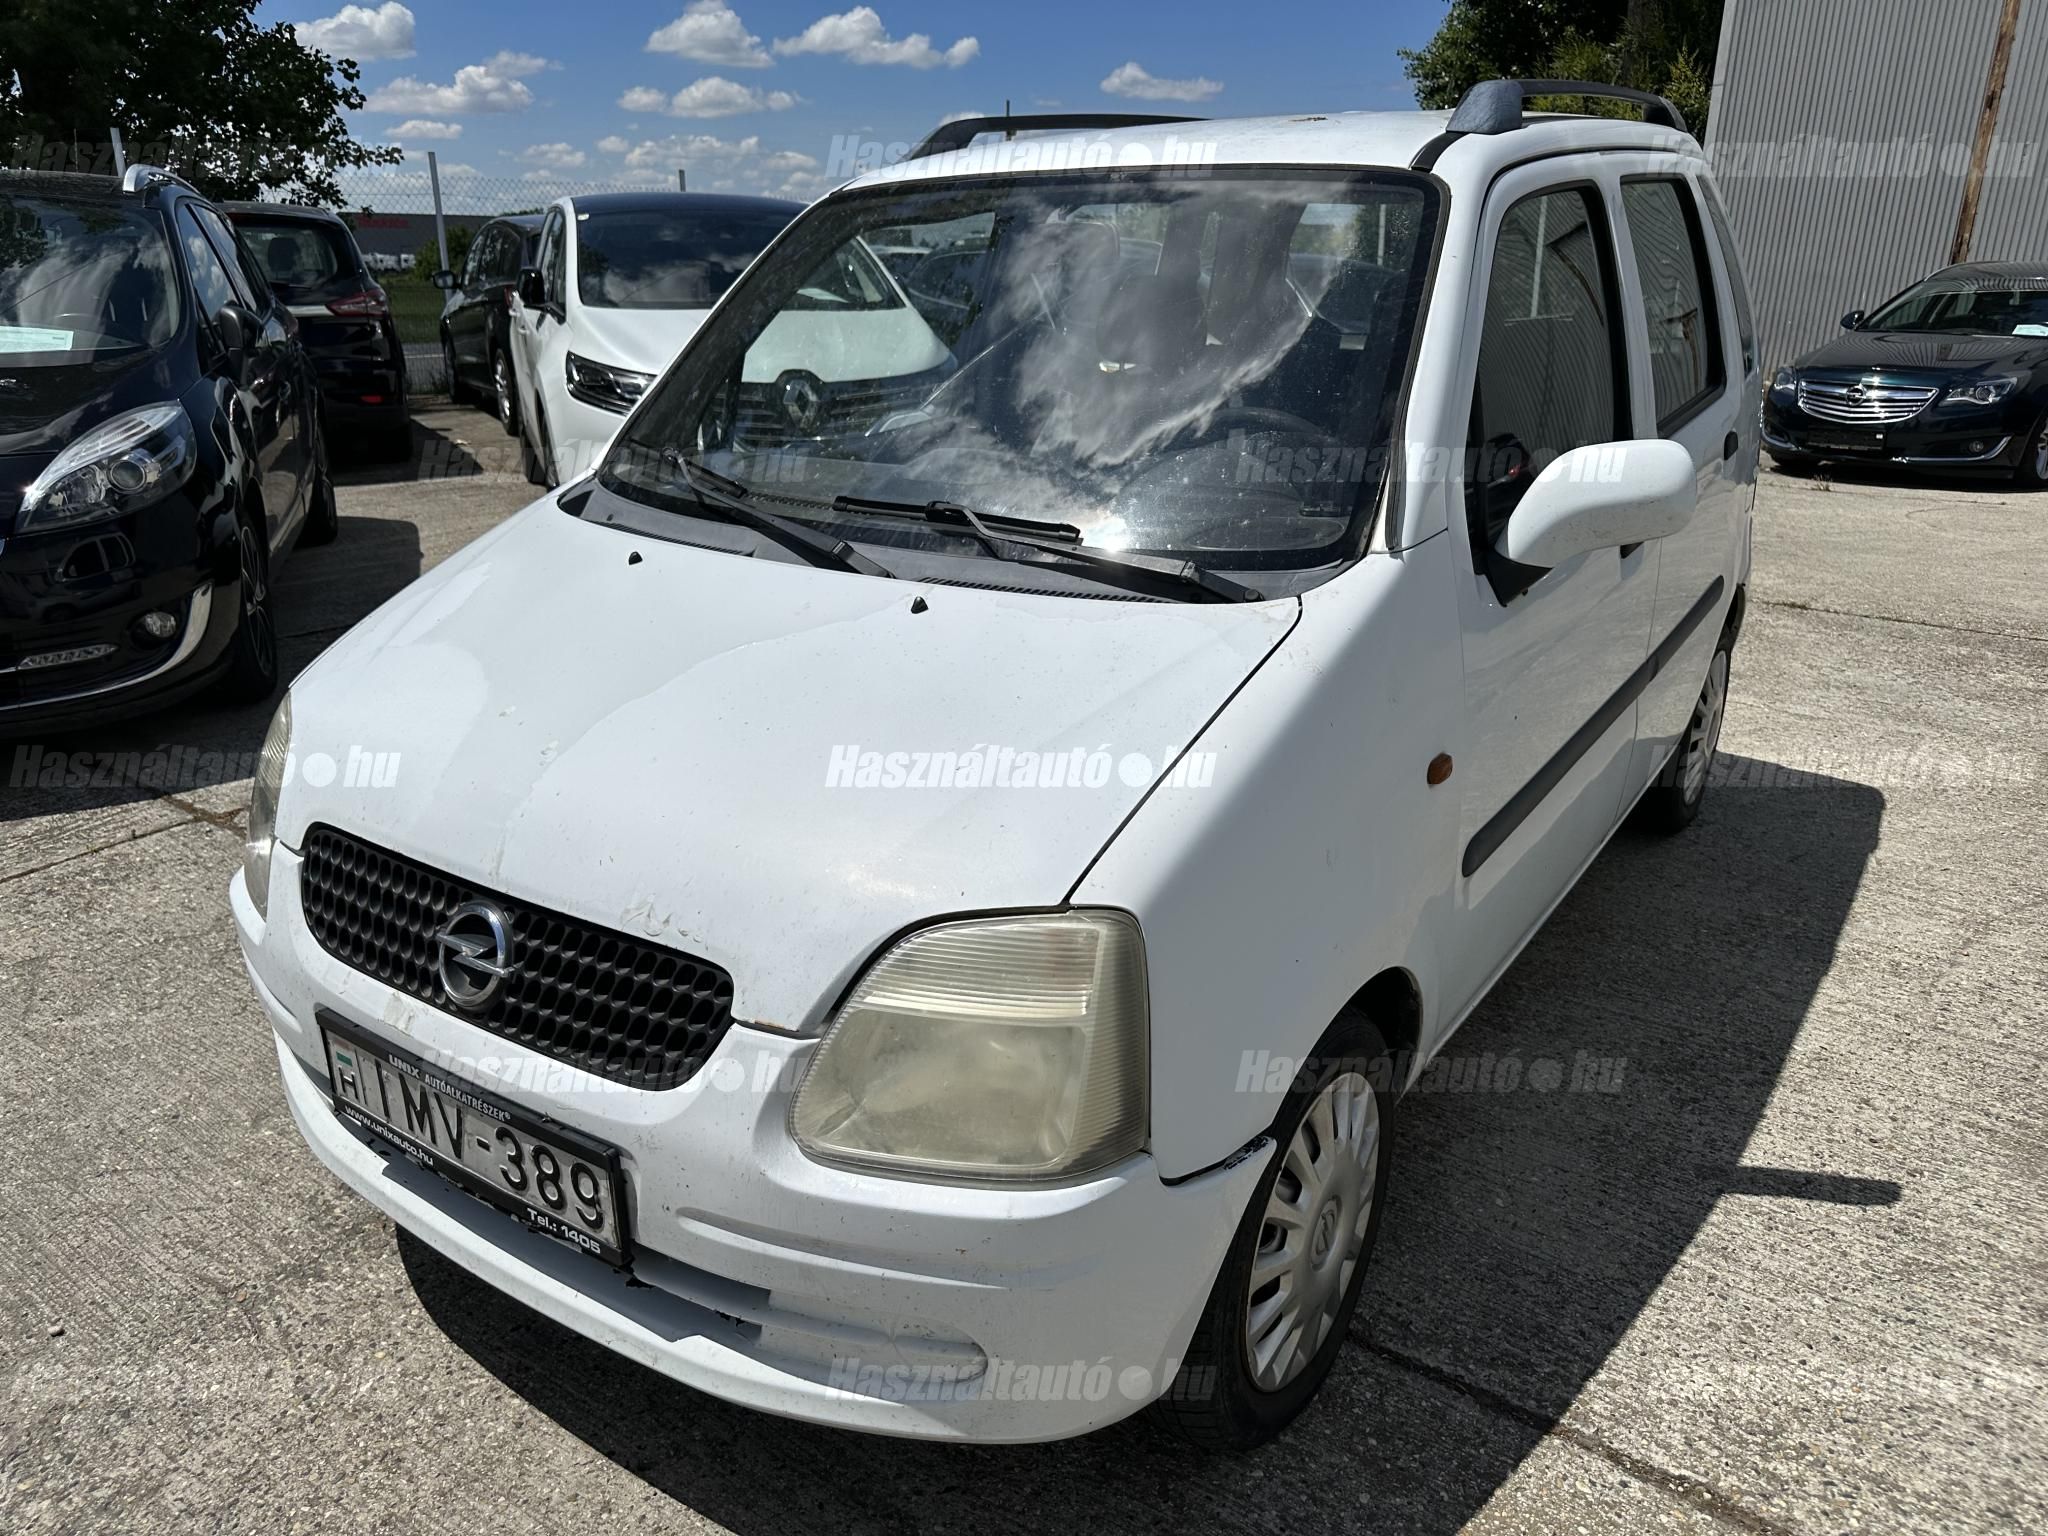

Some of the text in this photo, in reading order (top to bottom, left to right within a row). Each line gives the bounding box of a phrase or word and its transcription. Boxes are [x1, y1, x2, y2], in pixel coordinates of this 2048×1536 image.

[338, 1065, 359, 1100] H
[388, 1054, 420, 1079] UNIX
[345, 1104, 434, 1167] www.unixauto.hu
[527, 1207, 601, 1254] Tel.: 1405
